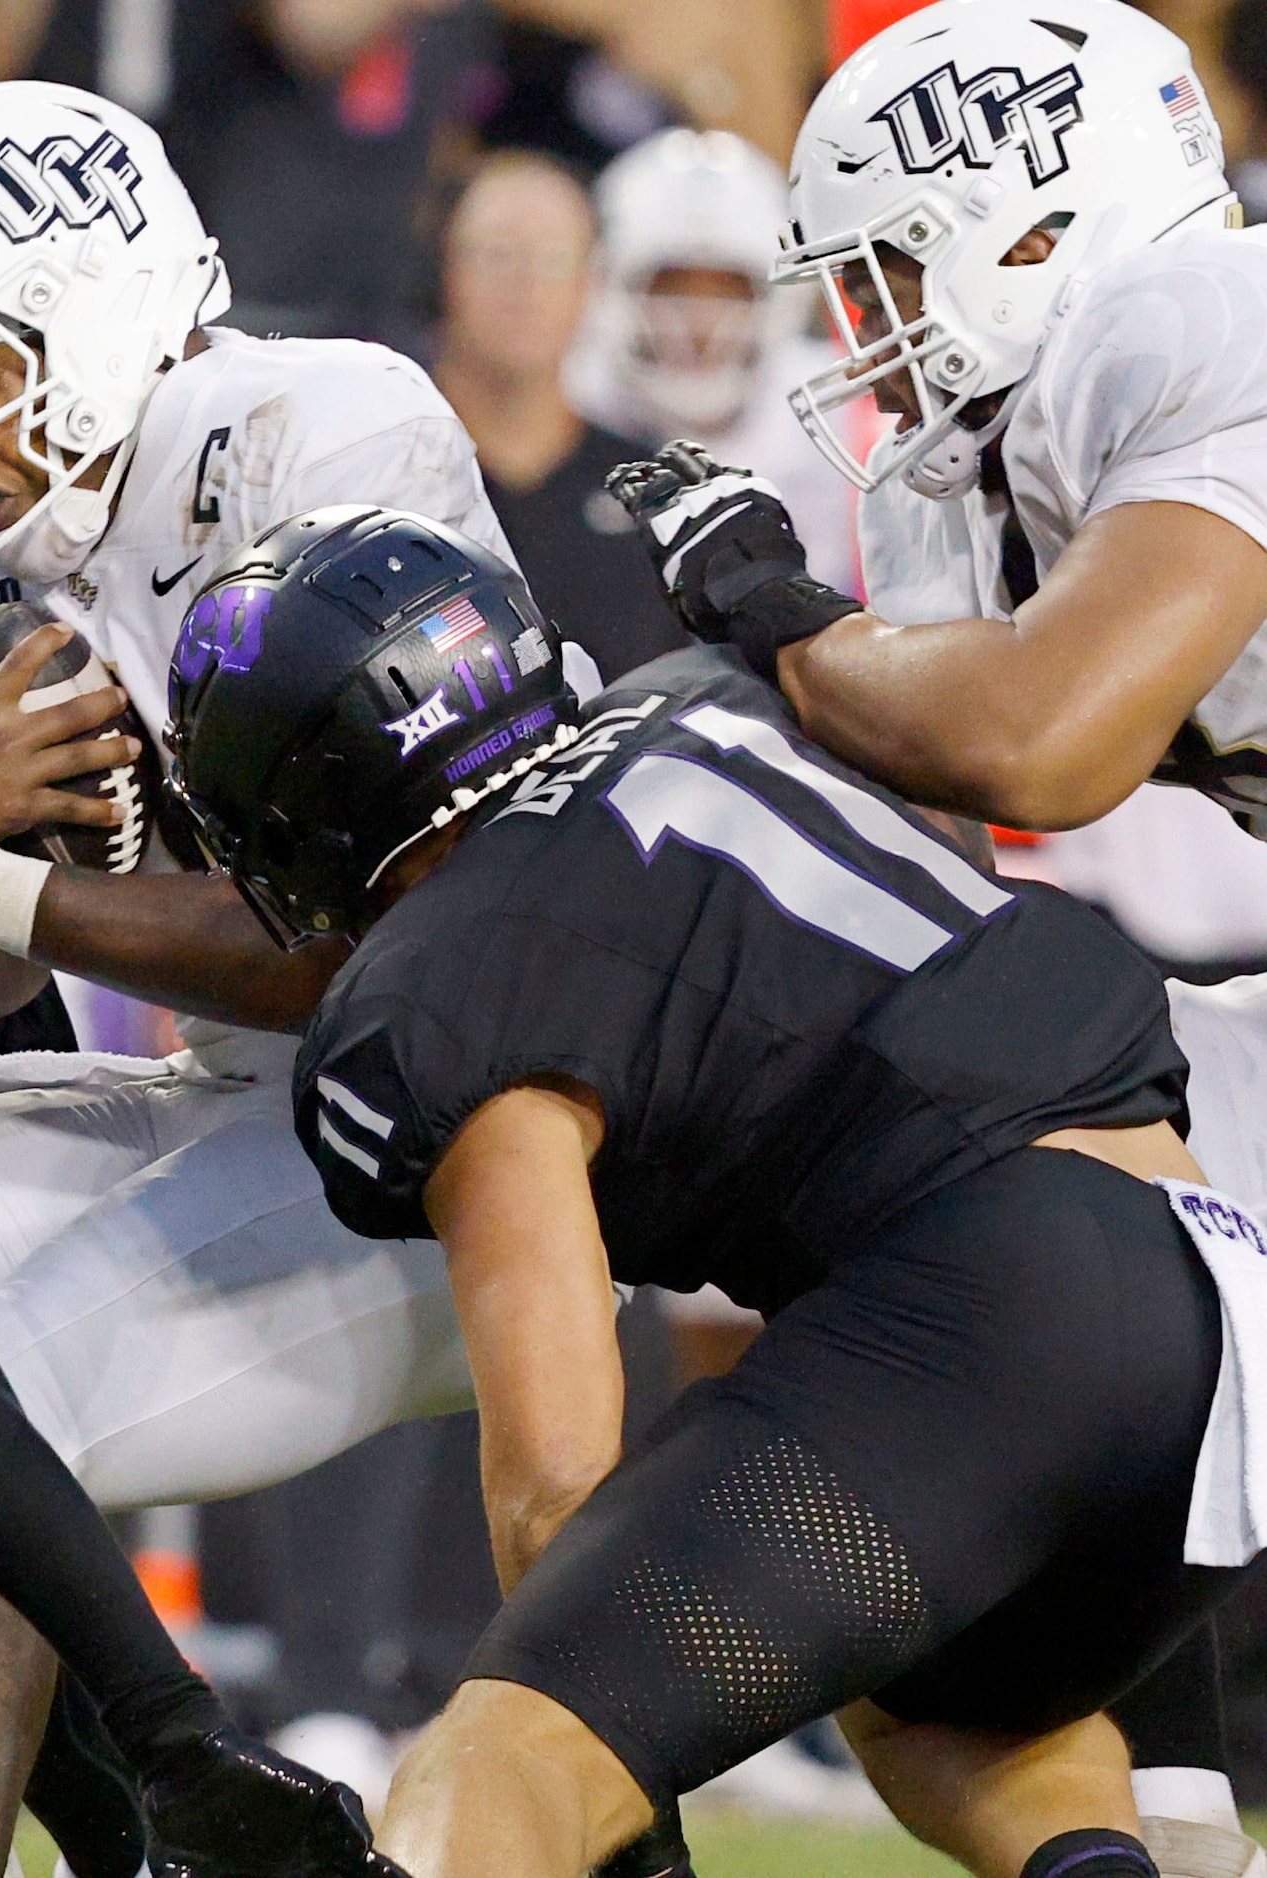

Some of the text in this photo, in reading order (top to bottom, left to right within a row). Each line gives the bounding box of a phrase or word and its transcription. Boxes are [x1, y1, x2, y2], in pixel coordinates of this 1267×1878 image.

[866, 60, 1084, 189] UCF
[192, 426, 232, 524] C
[382, 685, 464, 760] XII
[452, 640, 515, 712] 11
[444, 703, 557, 784] HORNED FROGS
[598, 703, 1023, 977] 11
[316, 1073, 396, 1181] 11
